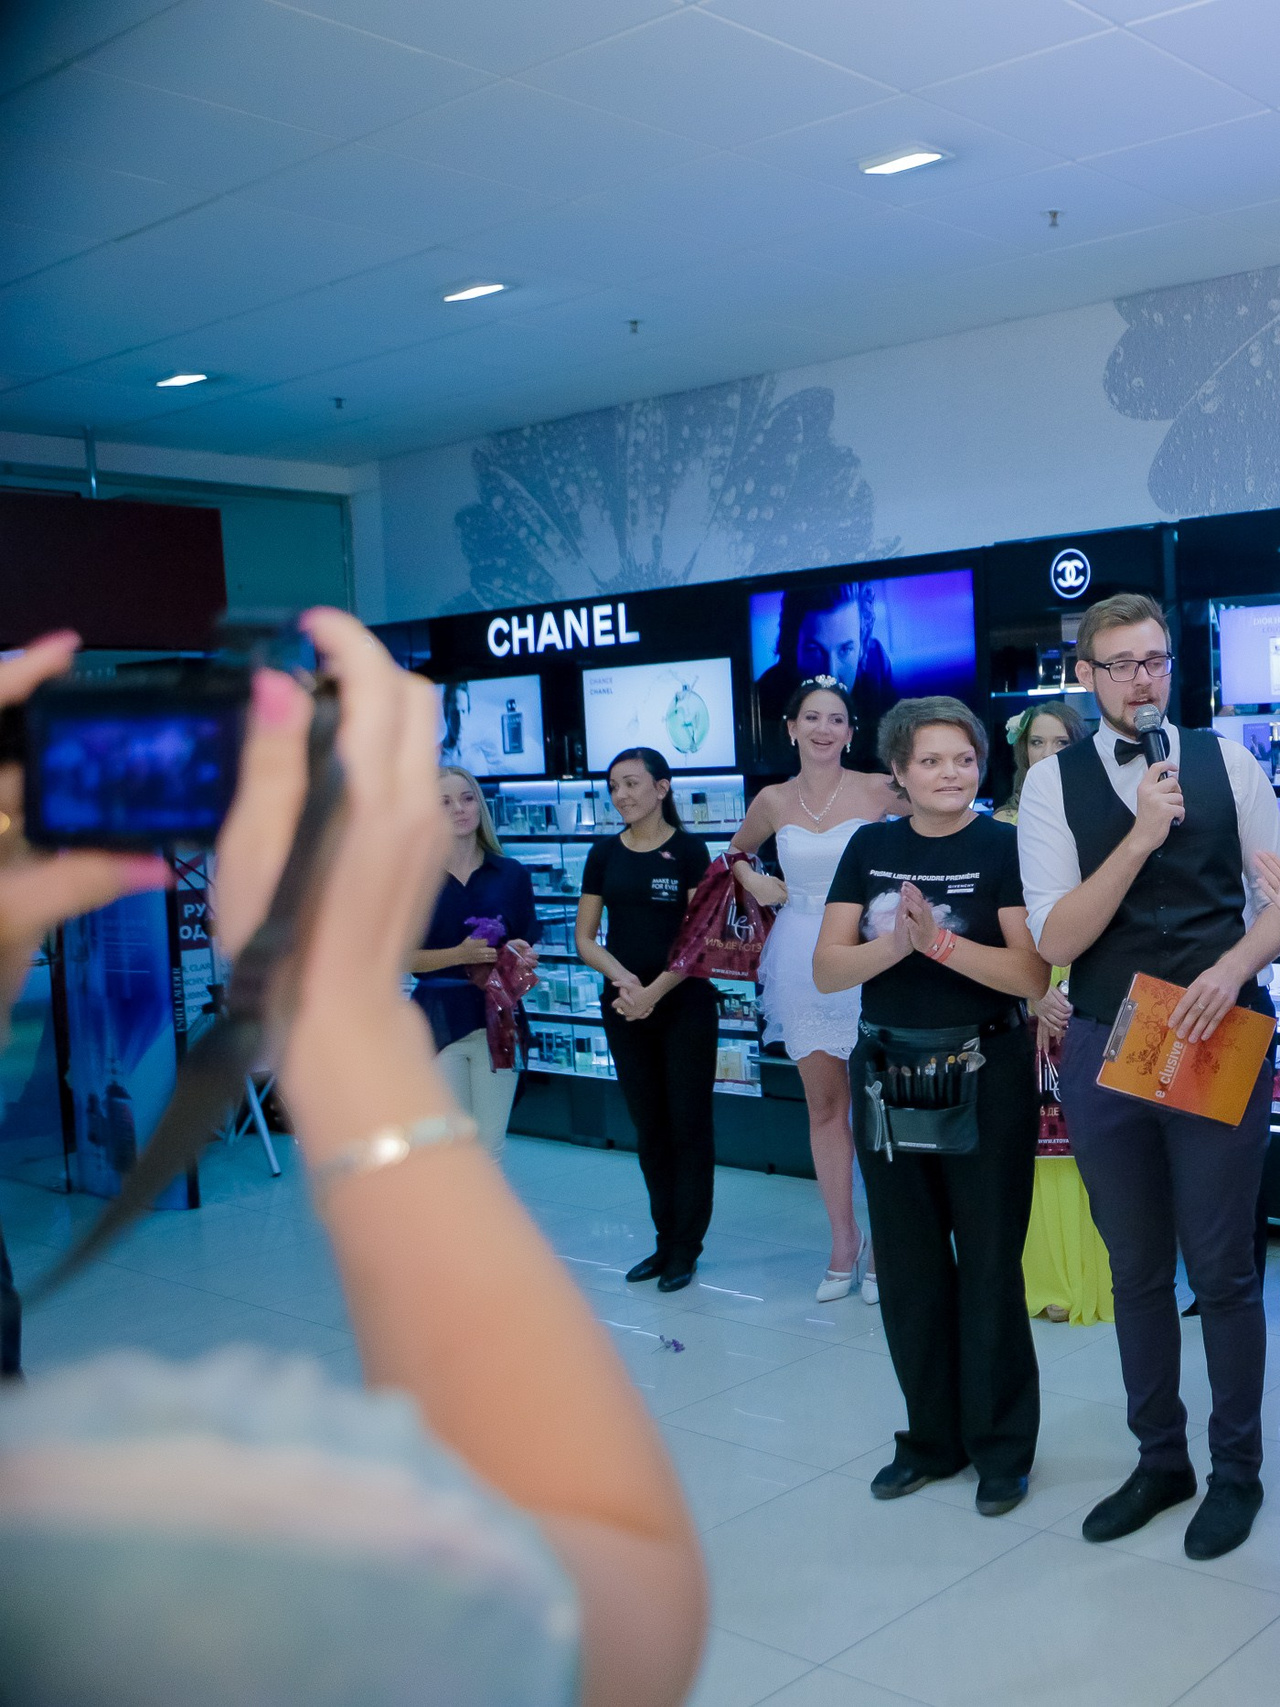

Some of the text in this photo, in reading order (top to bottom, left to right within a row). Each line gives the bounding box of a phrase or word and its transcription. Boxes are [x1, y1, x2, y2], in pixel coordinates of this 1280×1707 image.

[1253, 617, 1273, 626] DIOR
[487, 602, 640, 657] CHANEL
[590, 687, 613, 695] CHANEL
[869, 869, 893, 878] PRISME
[945, 872, 981, 881] PREMIÈRE
